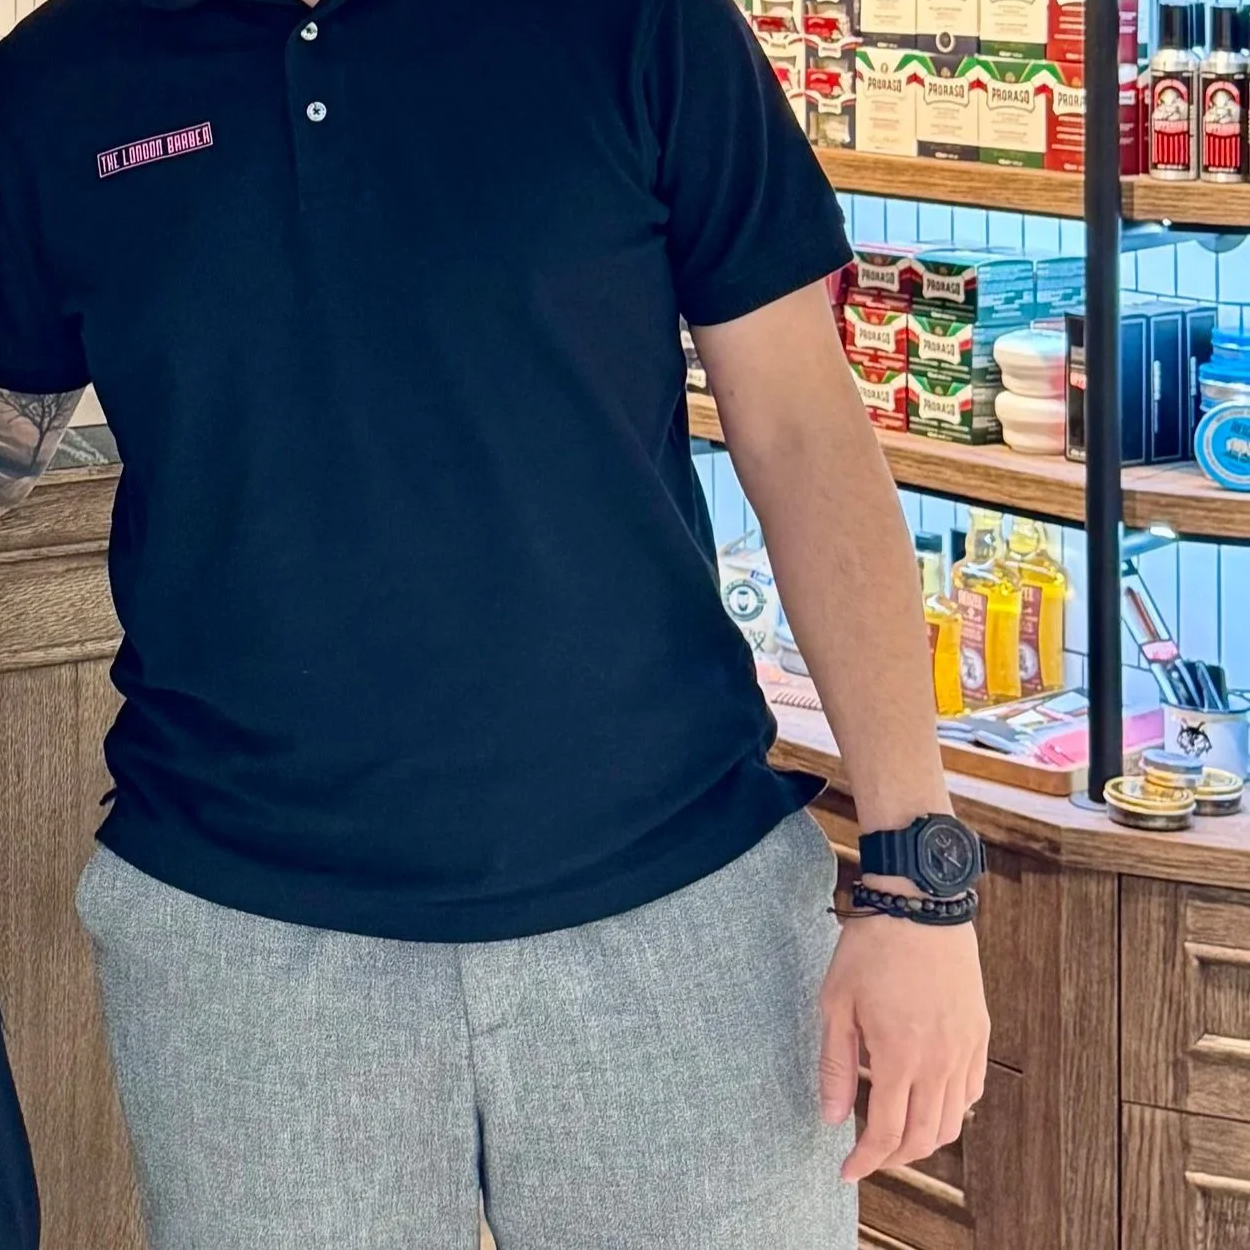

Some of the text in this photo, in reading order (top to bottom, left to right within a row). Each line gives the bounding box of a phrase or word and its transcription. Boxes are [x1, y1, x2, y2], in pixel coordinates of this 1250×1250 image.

[867, 76, 902, 92] PRORASO
[928, 83, 965, 100] PRORASO
[991, 88, 1030, 105] PRORASO
[101, 126, 211, 173] THE LONDON BARBER
[861, 268, 895, 285] PRORASO
[926, 279, 961, 296] PRORASO
[859, 328, 891, 346] PRORASO
[923, 340, 956, 357] PRORASO
[923, 398, 956, 417] PRORASO
